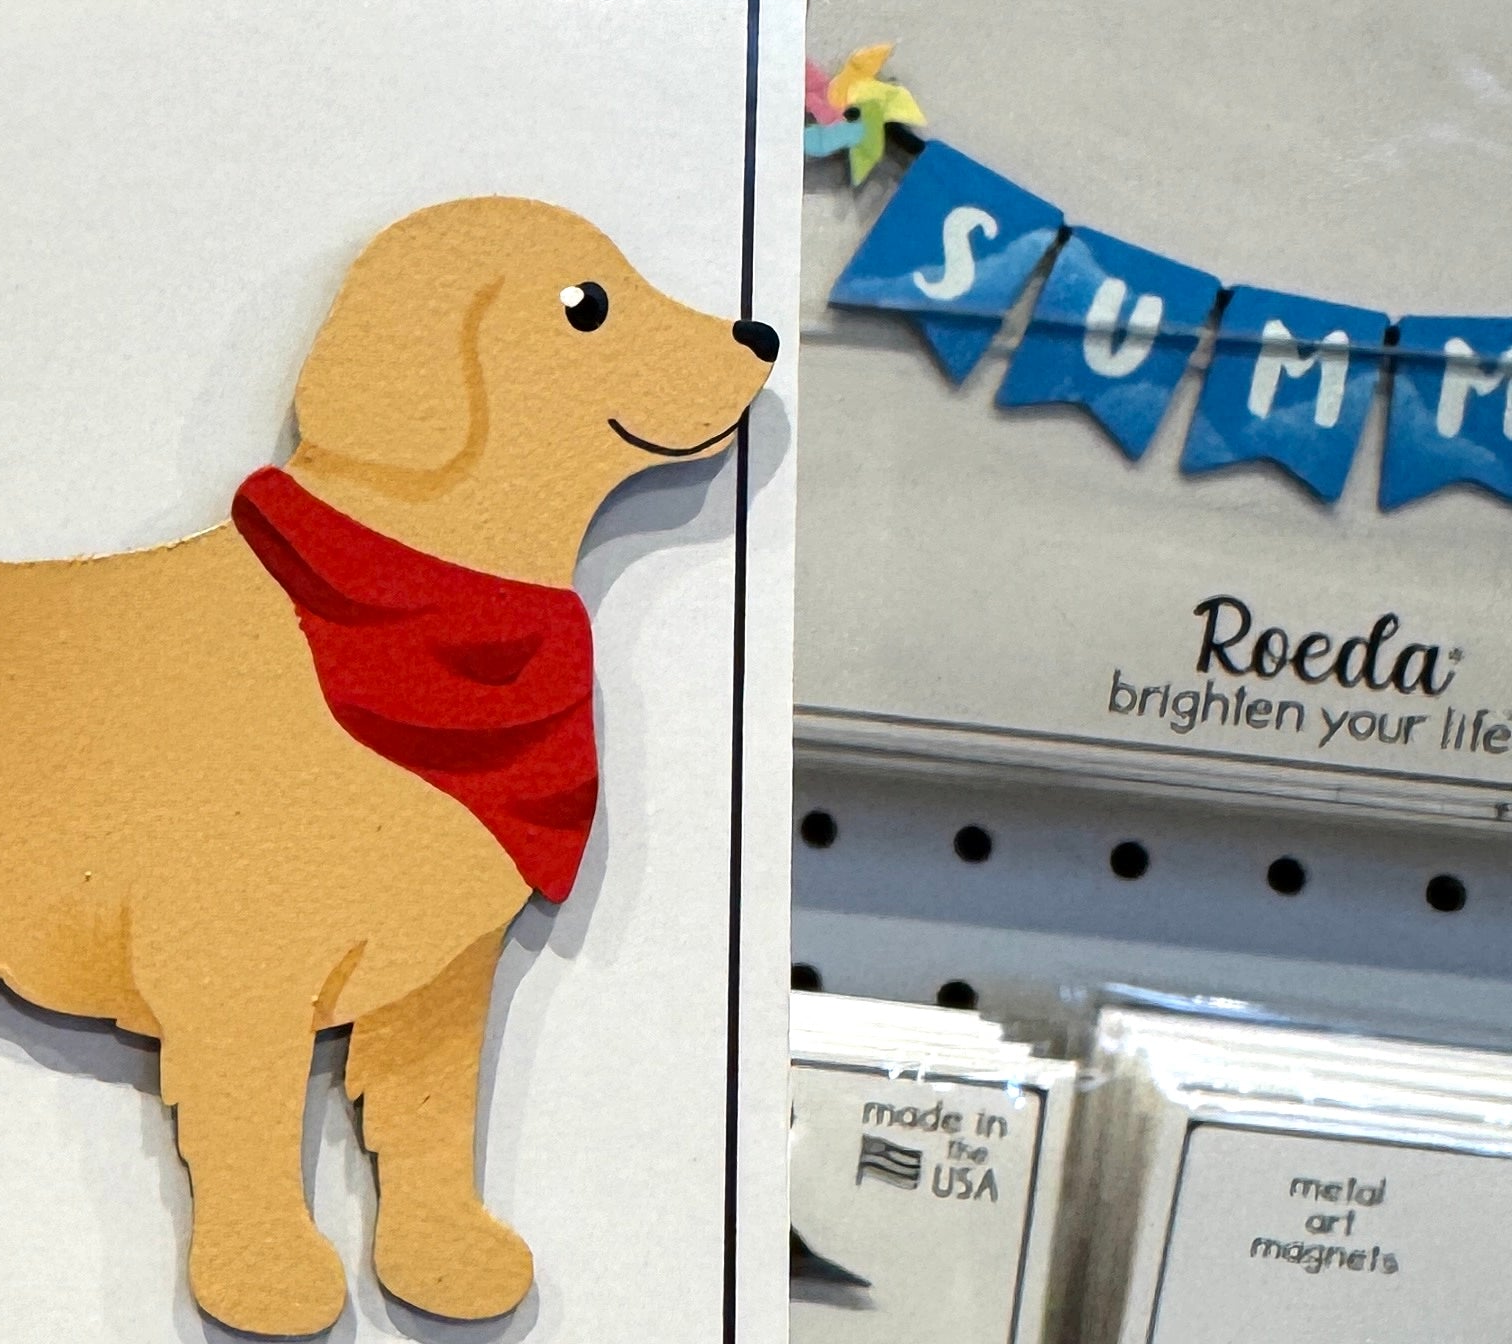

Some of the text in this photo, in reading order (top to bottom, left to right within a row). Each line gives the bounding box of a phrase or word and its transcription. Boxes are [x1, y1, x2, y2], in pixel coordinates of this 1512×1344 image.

[1192, 594, 1463, 697] Roeda
[1108, 668, 1306, 735] brighten
[1318, 707, 1428, 749] your
[861, 1100, 1008, 1139] made in
[931, 1163, 999, 1203] USA
[1289, 1177, 1387, 1207] metal
[1304, 1209, 1356, 1237] art
